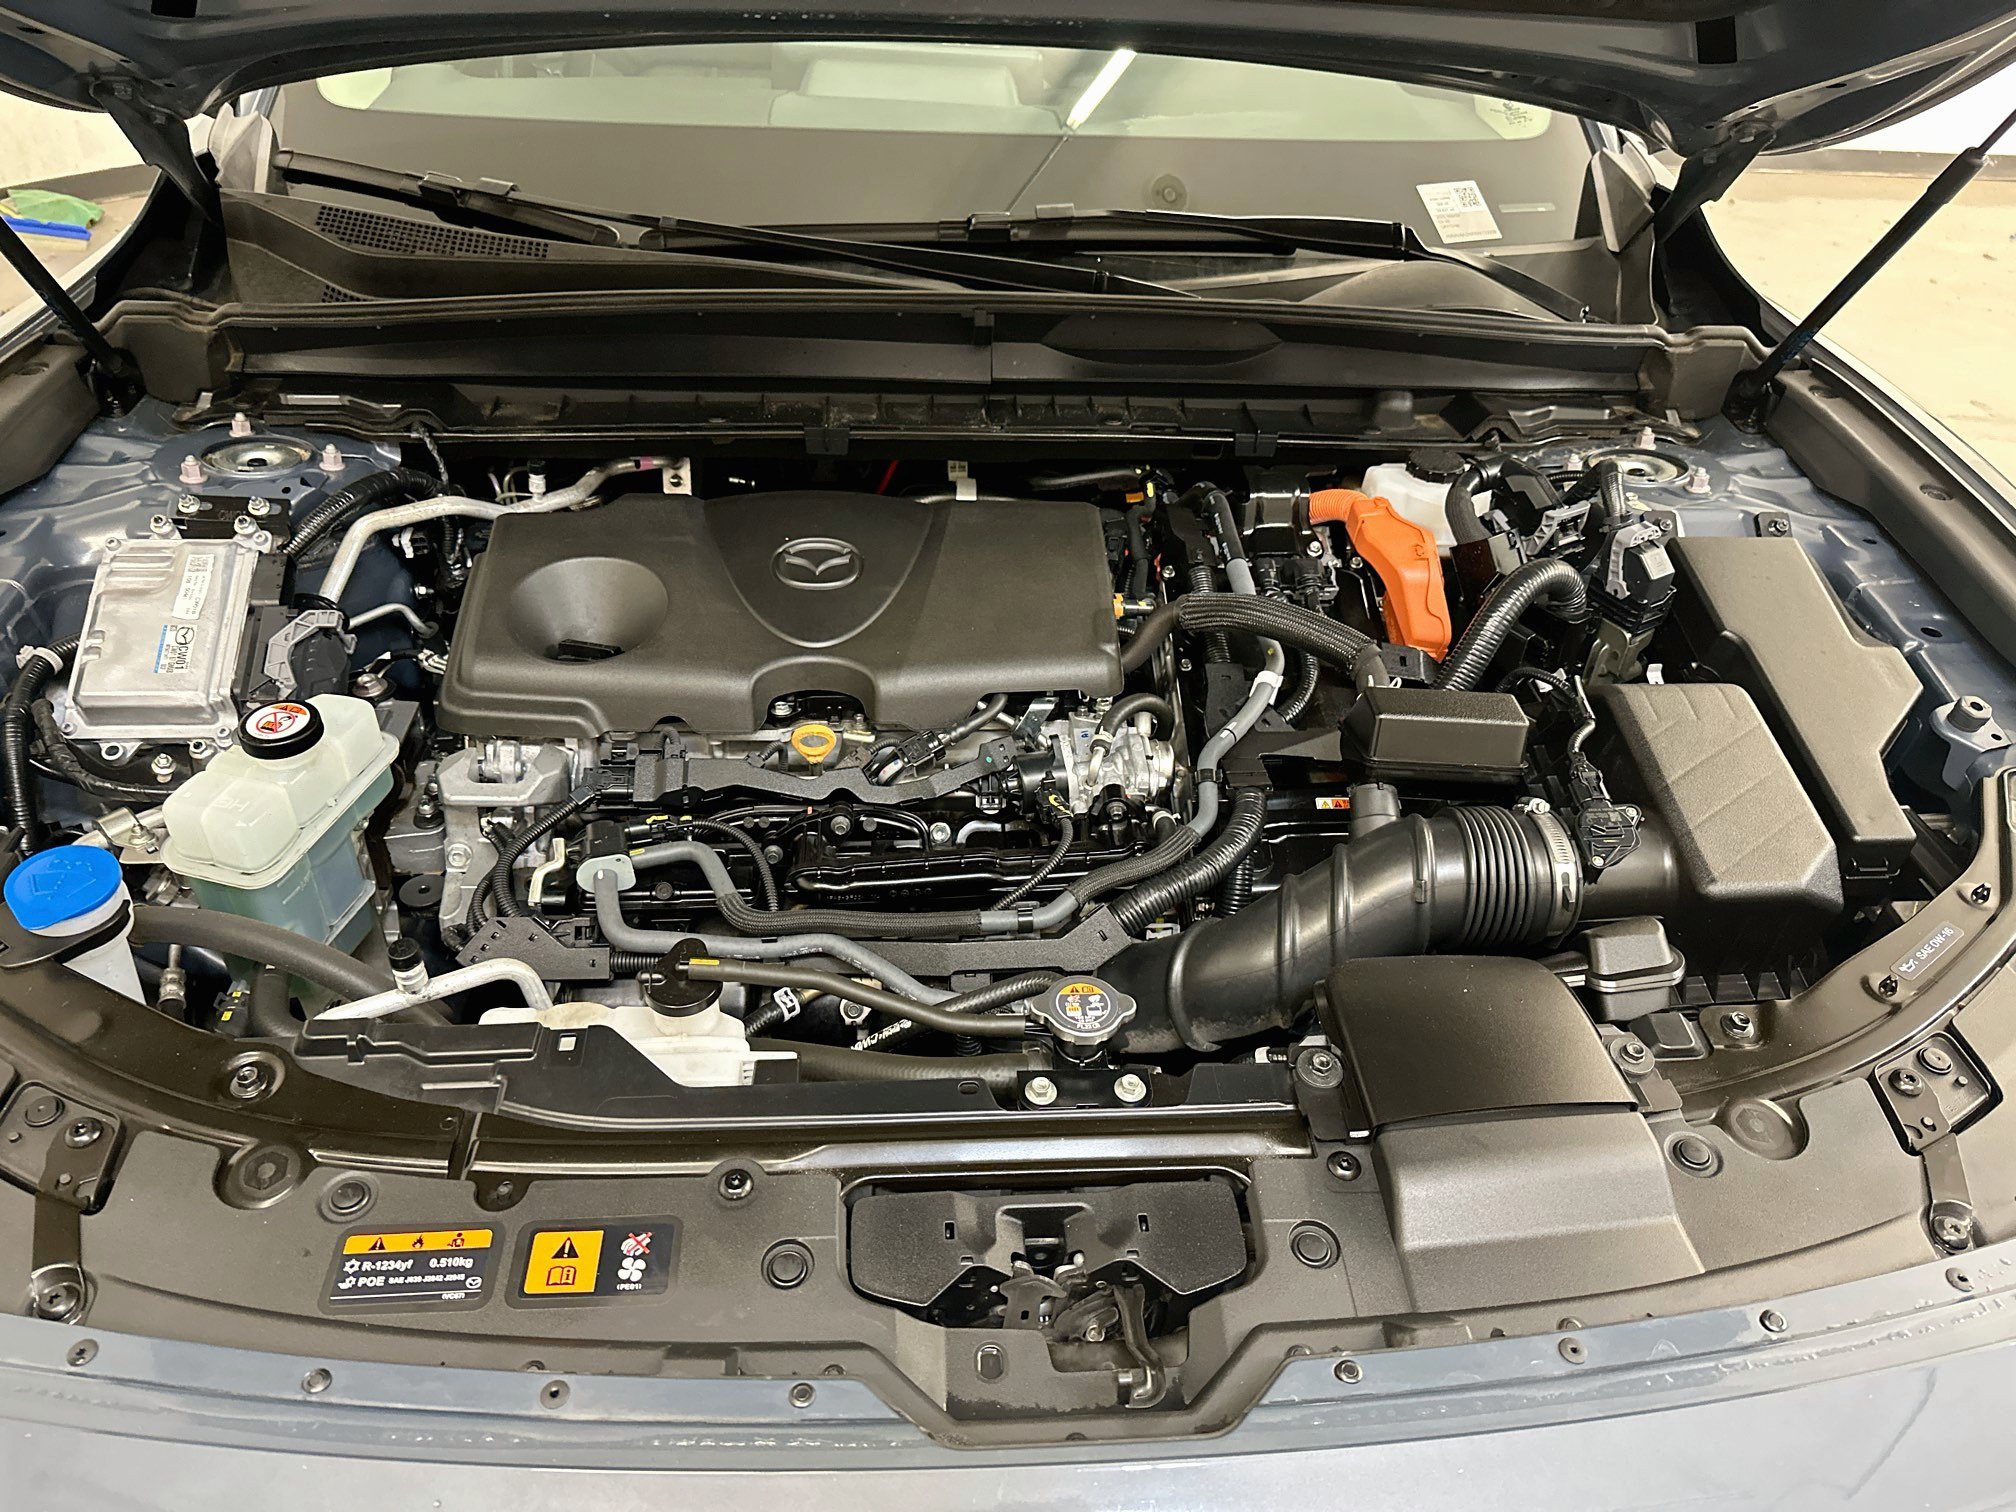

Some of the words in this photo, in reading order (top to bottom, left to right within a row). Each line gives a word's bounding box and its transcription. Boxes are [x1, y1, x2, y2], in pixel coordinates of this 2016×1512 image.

[175, 646, 189, 670] CW01
[1915, 944, 1935, 960] SAE
[1929, 927, 1954, 948] 0W-16
[361, 1258, 414, 1272] R-1234yf
[429, 1257, 474, 1269] 0.510kg
[357, 1276, 386, 1288] POE
[388, 1276, 405, 1284] SAE
